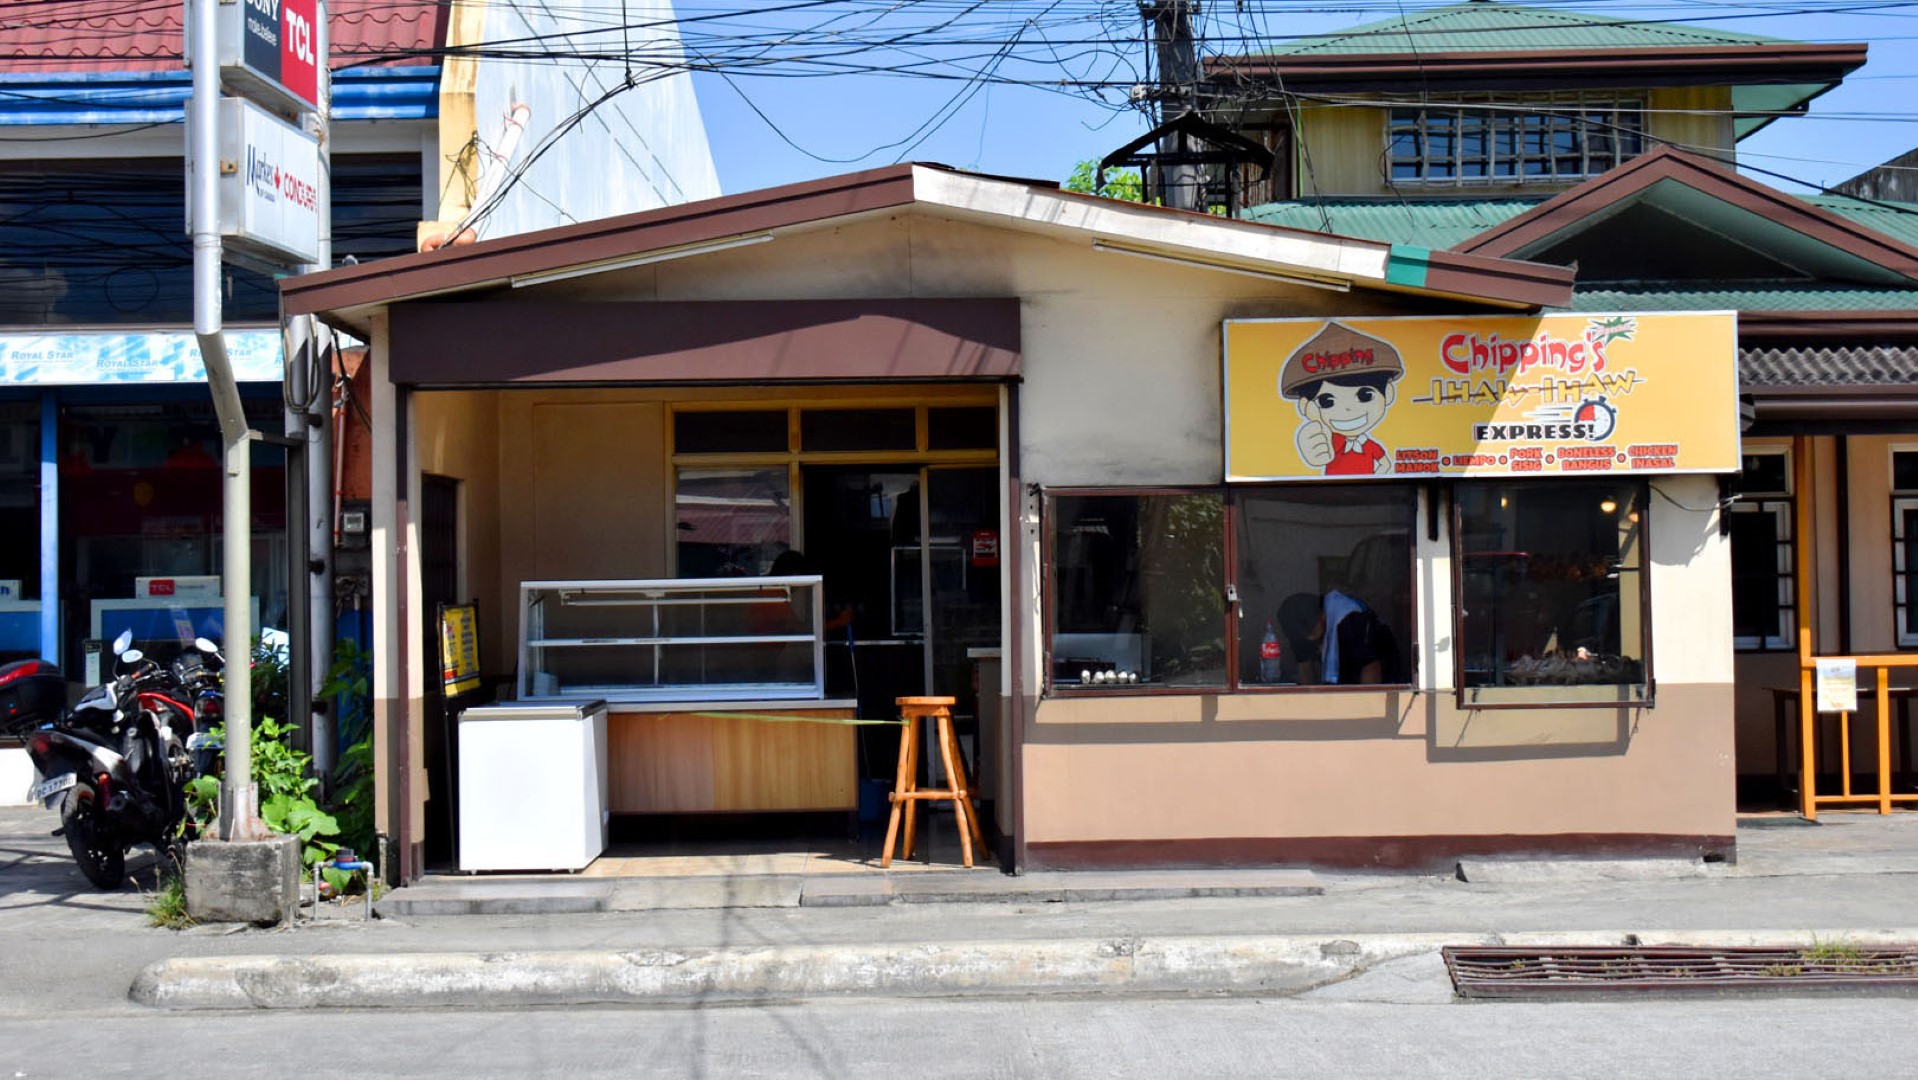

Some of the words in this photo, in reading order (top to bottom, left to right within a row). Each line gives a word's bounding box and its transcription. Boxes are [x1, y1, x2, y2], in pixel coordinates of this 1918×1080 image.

[286, 7, 315, 67] TCL
[1441, 331, 1606, 375] Chipping's
[1302, 347, 1374, 374] Chipping
[1474, 424, 1595, 440] EXPRESS!
[1396, 449, 1438, 460] LITSON
[1510, 448, 1543, 459] PORK
[1557, 446, 1616, 459] BONELESS
[1628, 445, 1678, 457] CHICKEN
[1453, 456, 1496, 466] LIEMPO
[1511, 460, 1542, 472] SISIG
[1562, 459, 1611, 471] BANGUS
[1631, 458, 1675, 469] INASAL
[1395, 462, 1439, 473] MANOK
